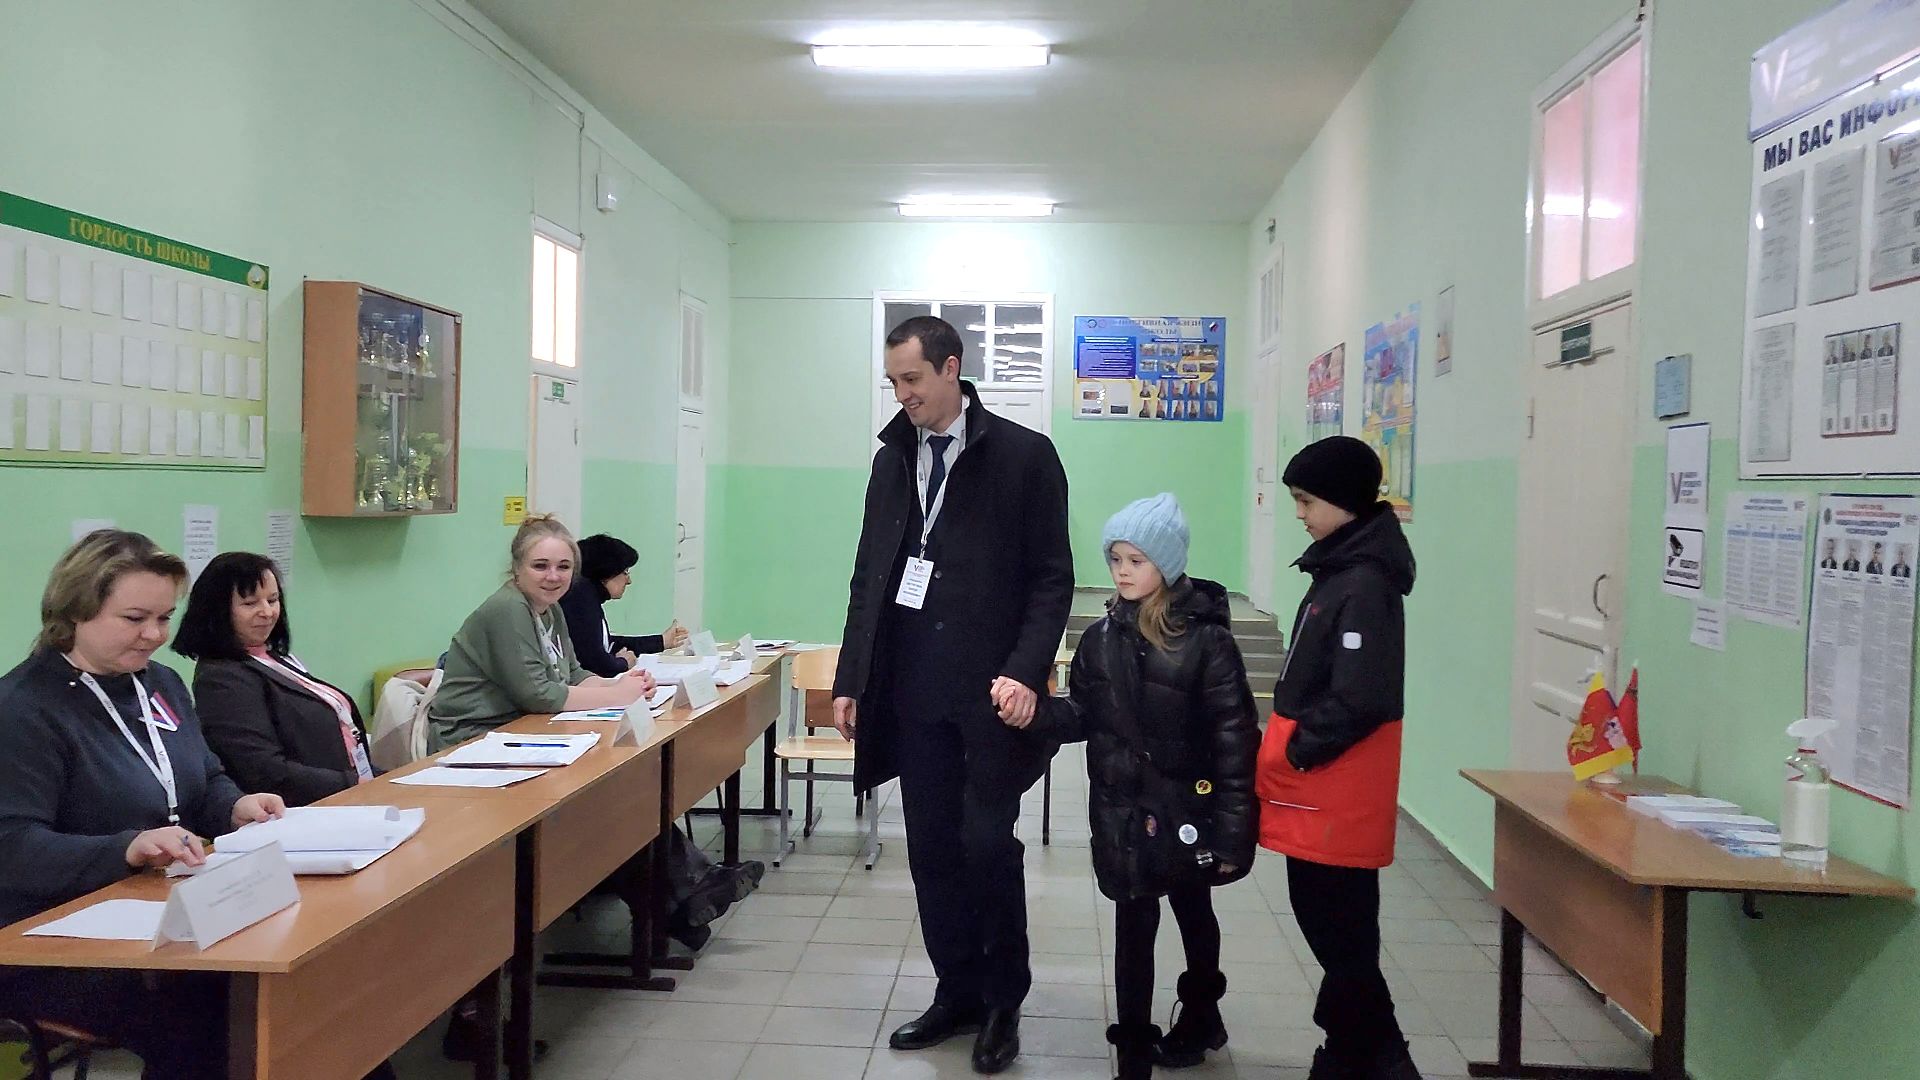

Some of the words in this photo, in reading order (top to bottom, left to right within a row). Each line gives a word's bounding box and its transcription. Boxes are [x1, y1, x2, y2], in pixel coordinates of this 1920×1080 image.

[1763, 137, 1793, 172] МЫ
[1799, 119, 1833, 157] ВАС
[1840, 92, 1920, 139] ИНФОР
[69, 217, 152, 256] ГОРДОСТЬ
[157, 241, 211, 271] ШКОЛЫ
